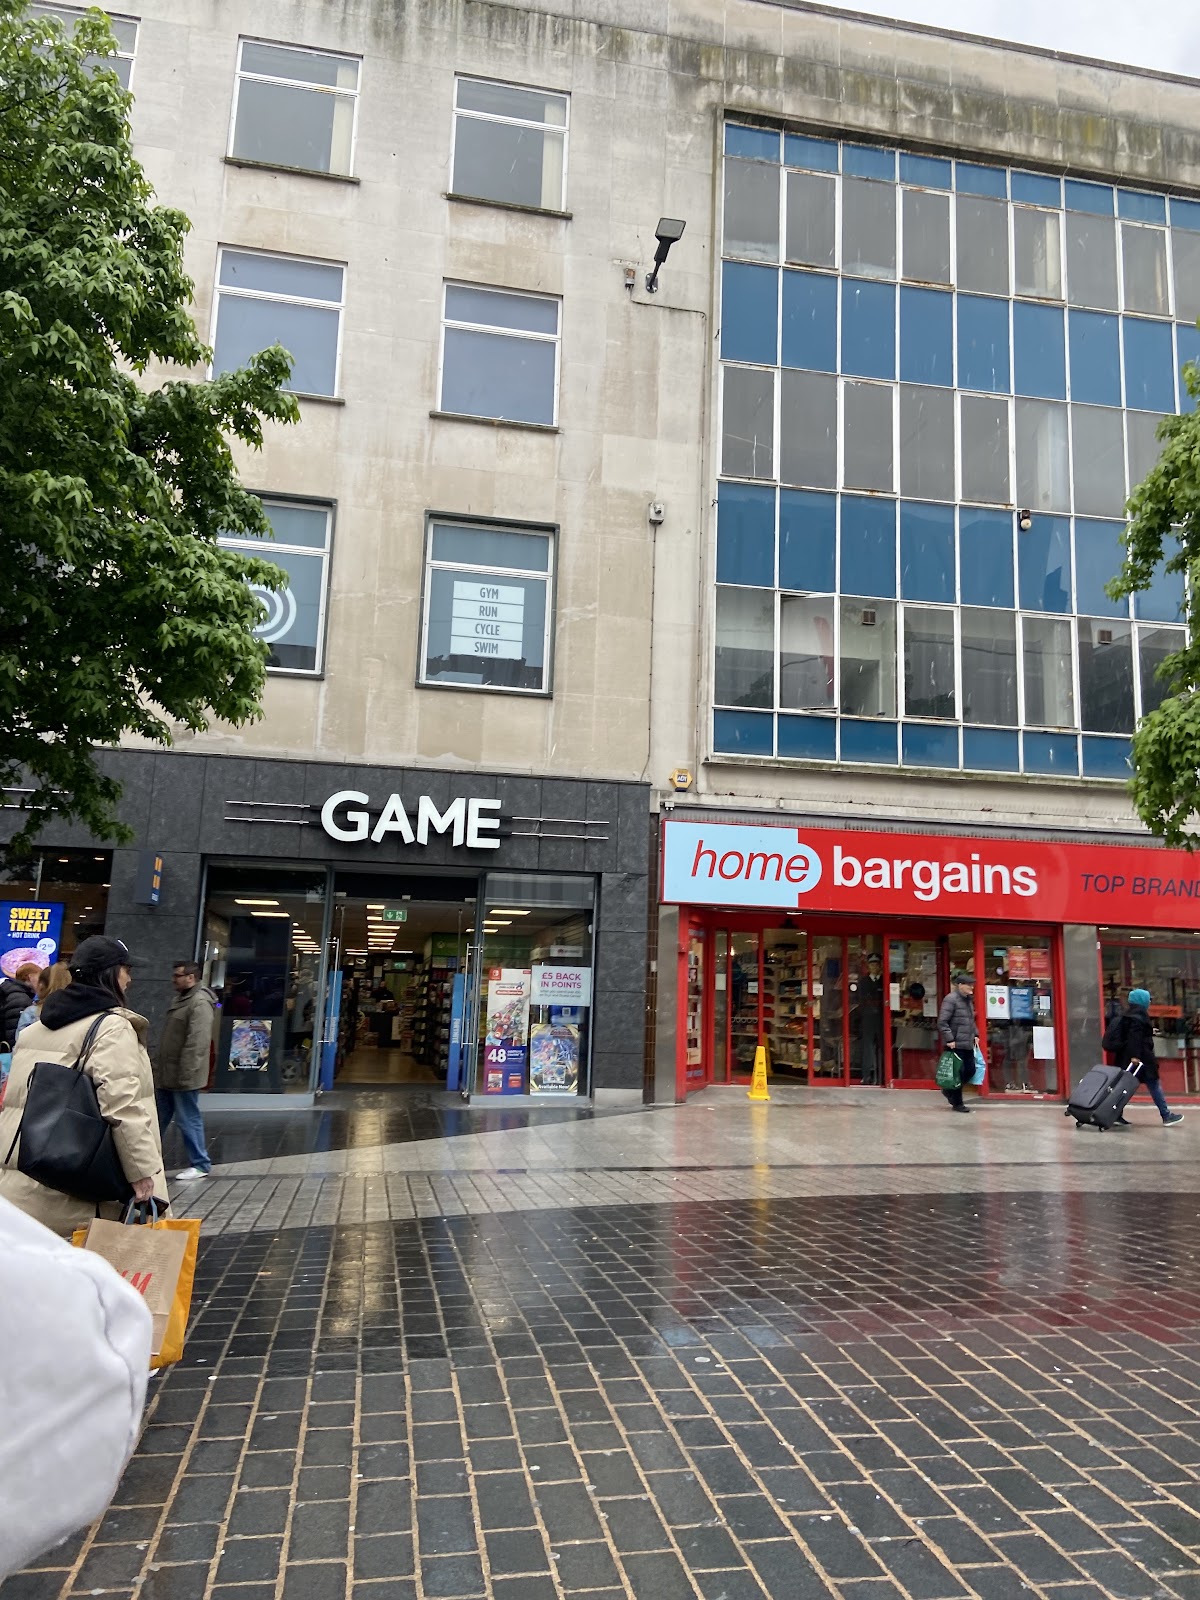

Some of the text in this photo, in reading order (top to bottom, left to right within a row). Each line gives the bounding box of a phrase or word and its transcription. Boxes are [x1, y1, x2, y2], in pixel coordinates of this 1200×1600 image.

[480, 588, 499, 599] GYM
[479, 606, 498, 618] RUN
[475, 623, 500, 636] CYCLE
[474, 641, 499, 654] SWIM
[320, 790, 502, 849] GAME
[691, 839, 1038, 901] home bargains
[1081, 874, 1125, 893] TOP
[10, 908, 51, 919] SWEET
[9, 920, 50, 932] TREAT
[556, 973, 581, 981] BACK
[552, 981, 582, 989] POINTS
[487, 1048, 507, 1063] 48
